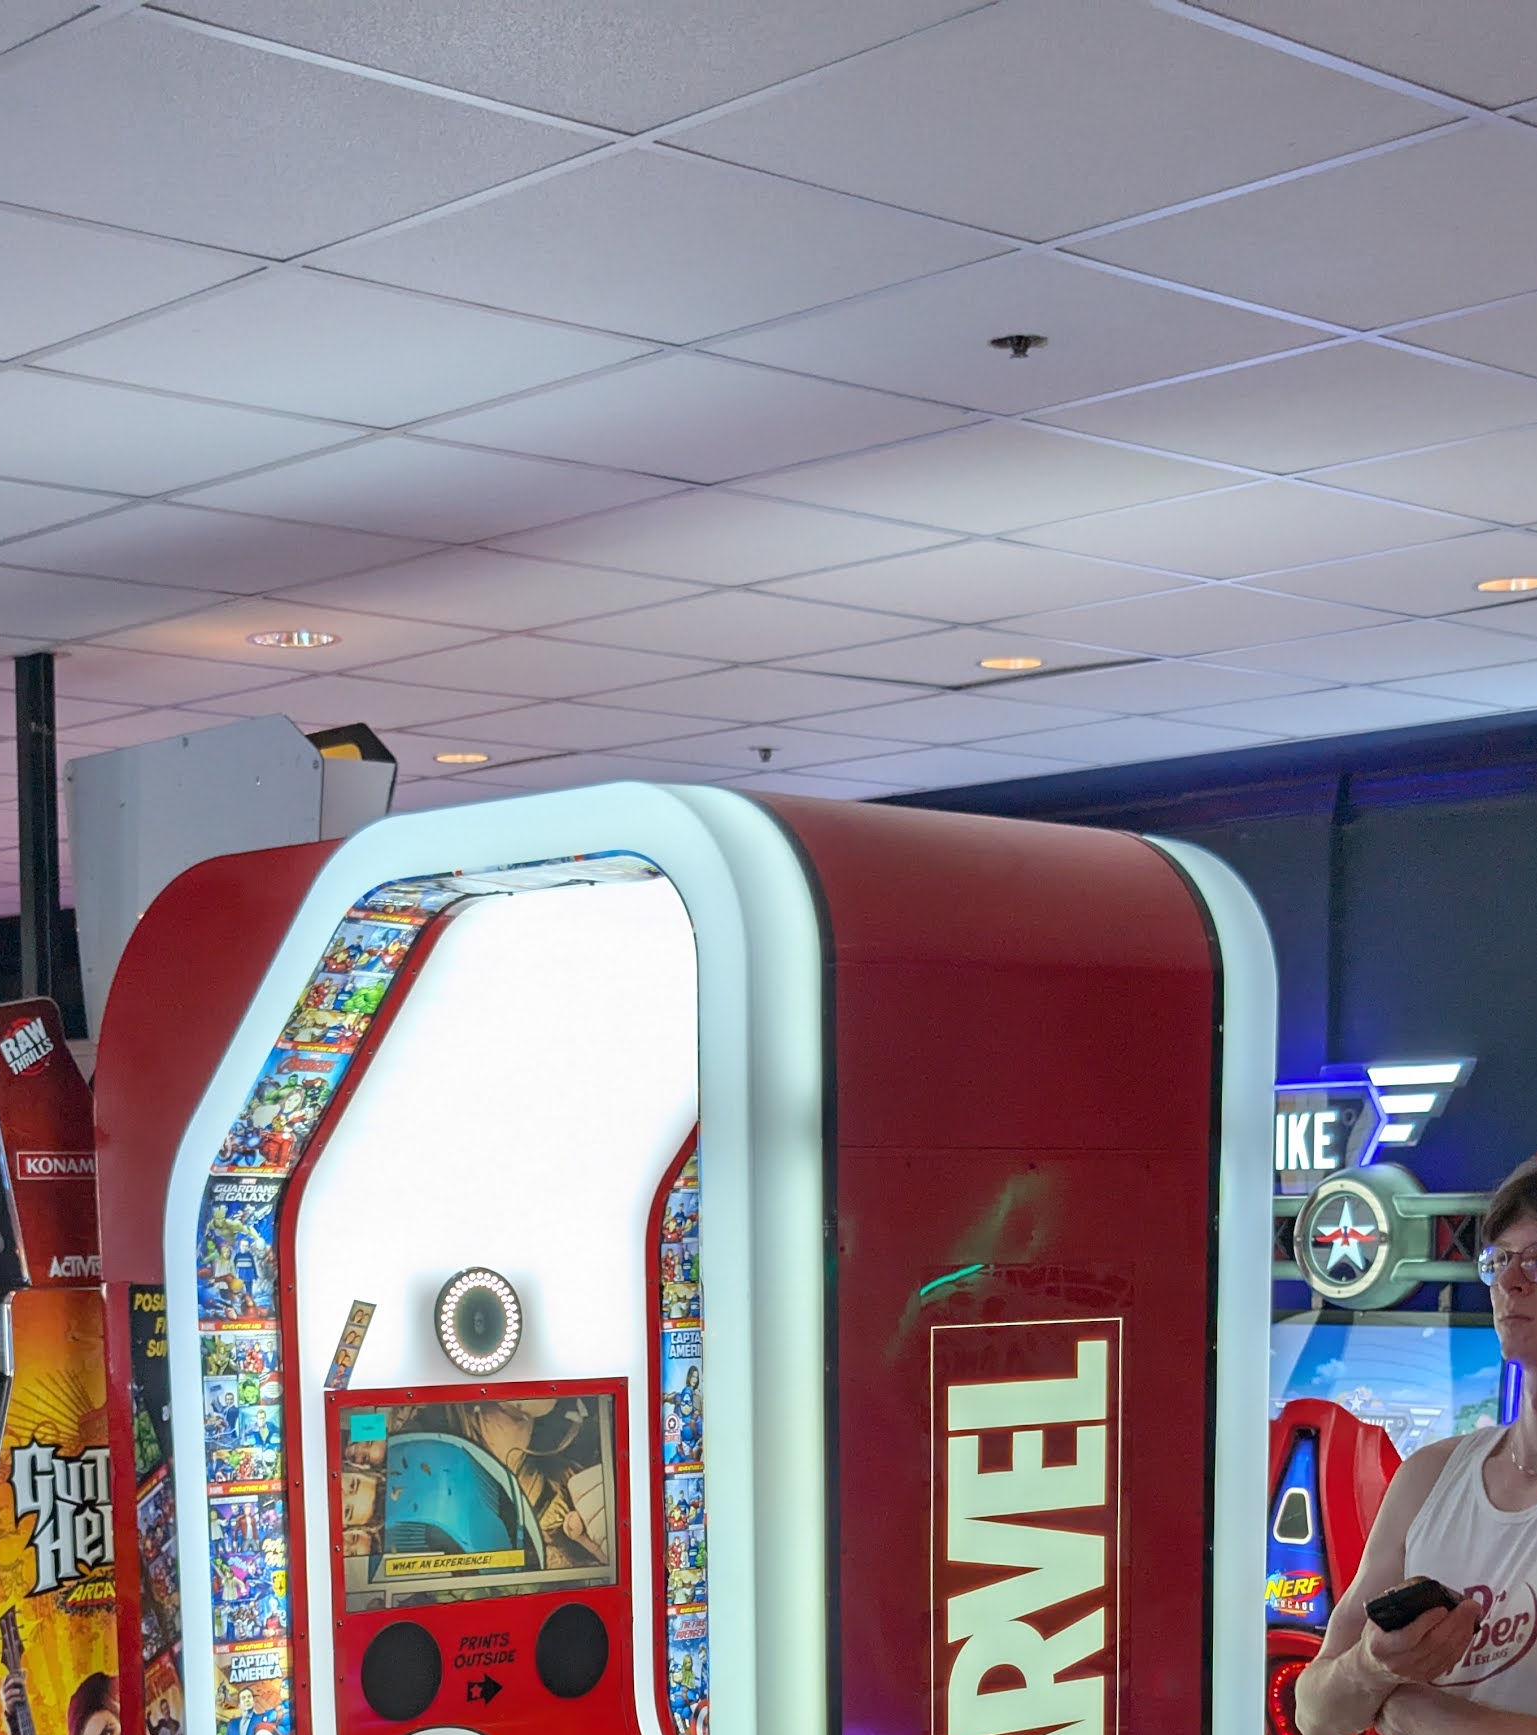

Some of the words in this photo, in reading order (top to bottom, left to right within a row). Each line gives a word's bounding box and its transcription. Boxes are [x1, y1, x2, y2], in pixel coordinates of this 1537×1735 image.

[0, 1017, 47, 1063] RAW
[8, 1037, 54, 1075] THRILLS
[1274, 1111, 1337, 1170] IKE
[26, 1156, 95, 1174] KONAM
[214, 1184, 280, 1194] GUARDIANS
[225, 1192, 277, 1203] GALAXY
[49, 1256, 101, 1277] ACTIVIS
[11, 1442, 110, 1537] GUIT
[392, 1560, 417, 1571] WHAT
[420, 1559, 432, 1568] AN
[433, 1556, 492, 1568] EXPERIENCE!
[68, 1582, 115, 1602] ARCA
[1265, 1575, 1322, 1600] NERF
[459, 1633, 509, 1651] PRINTS
[231, 1653, 279, 1669] CAPTAIN
[454, 1649, 515, 1670] OUTSIDE
[229, 1666, 282, 1683] AMERICA
